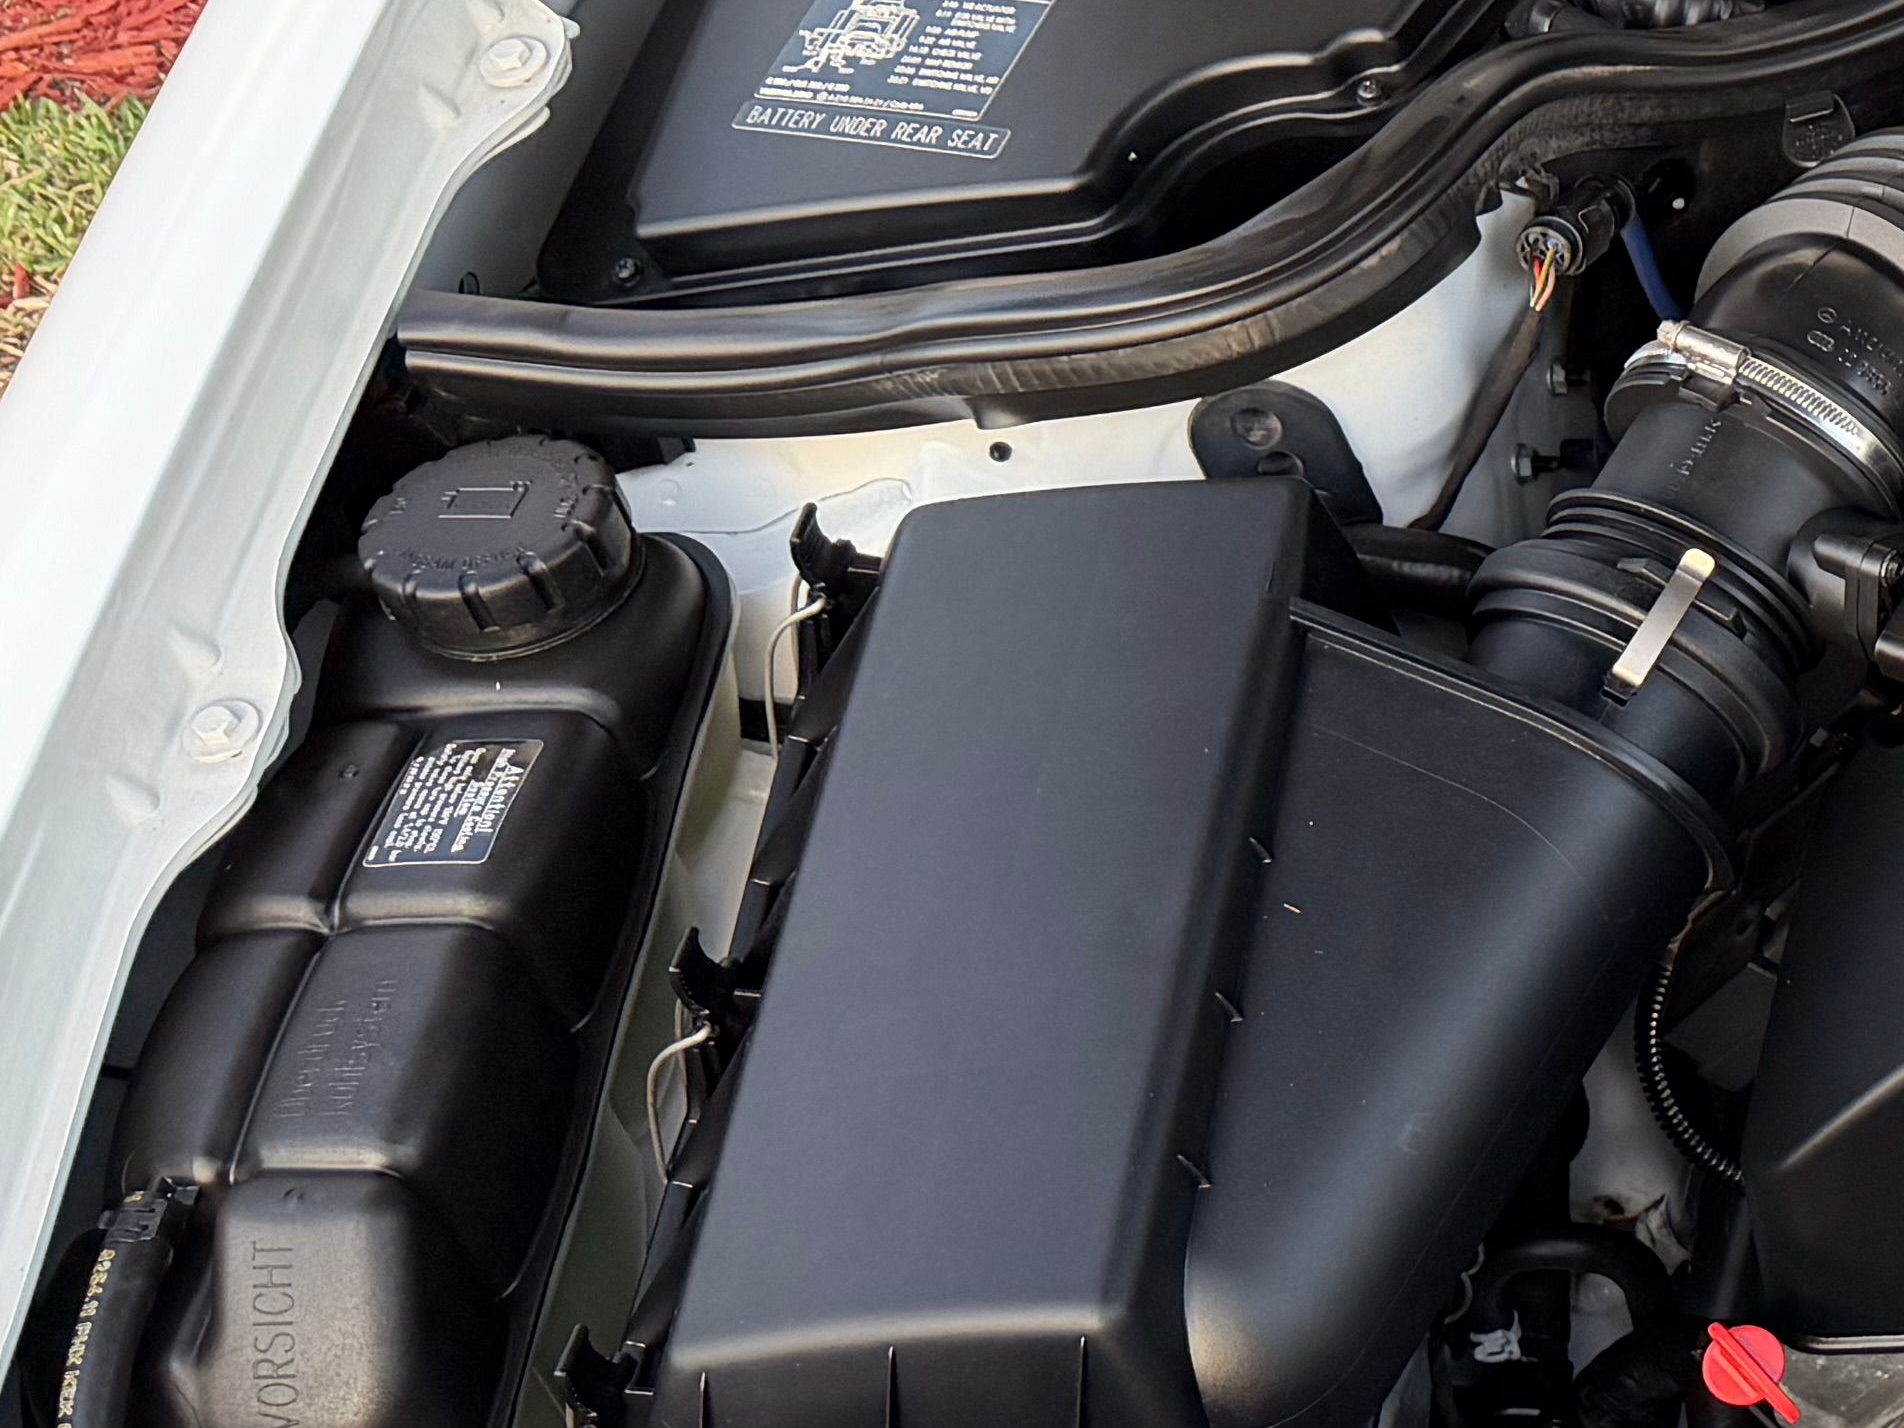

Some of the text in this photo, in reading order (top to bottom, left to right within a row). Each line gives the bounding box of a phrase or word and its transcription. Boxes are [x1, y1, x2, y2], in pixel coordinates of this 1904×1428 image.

[746, 105, 999, 152] BATTERY UNDER REAR SEAT
